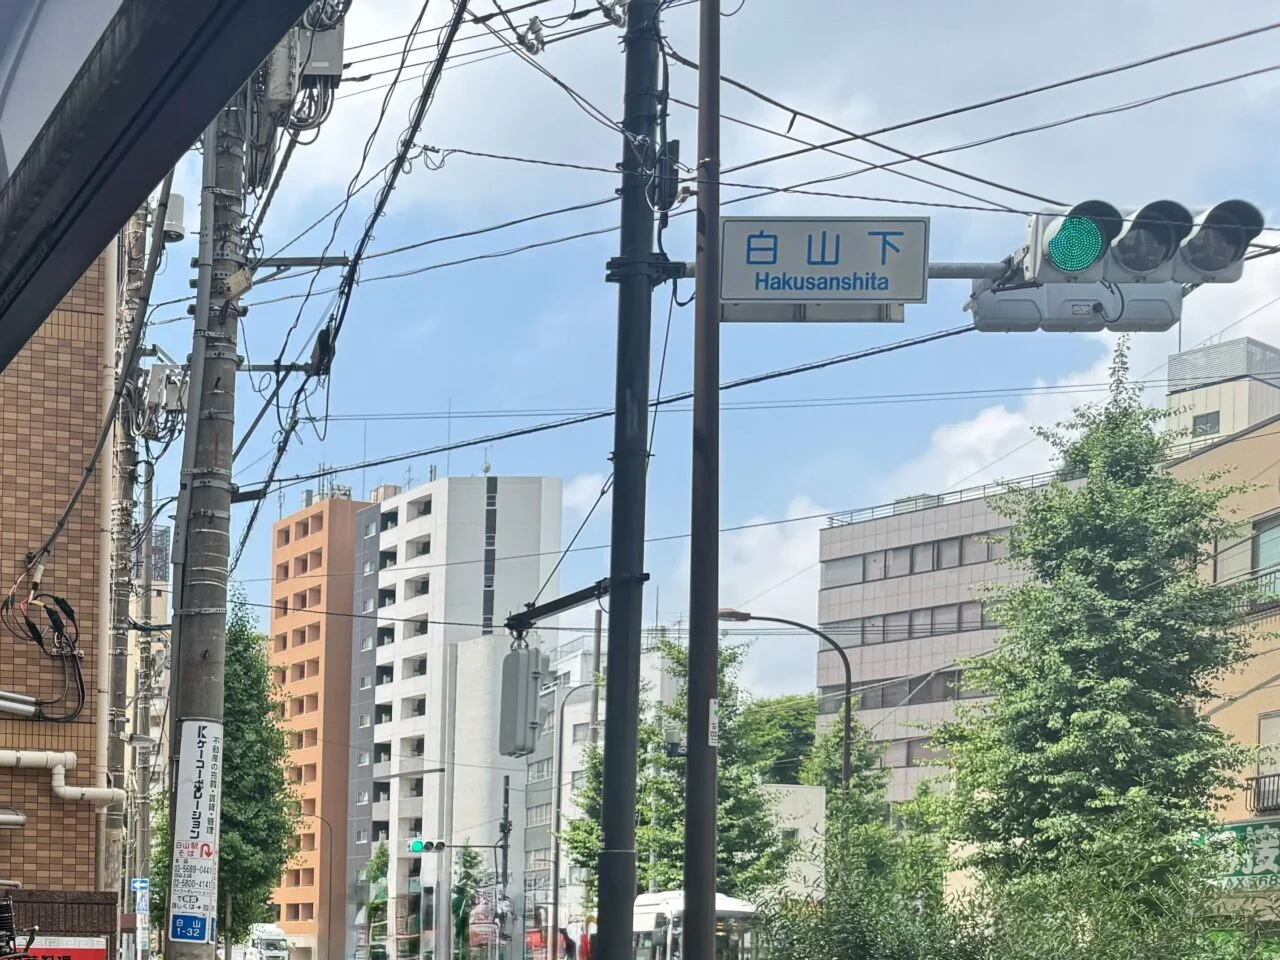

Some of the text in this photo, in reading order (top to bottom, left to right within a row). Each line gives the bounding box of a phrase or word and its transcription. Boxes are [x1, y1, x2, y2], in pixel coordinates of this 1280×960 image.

[746, 230, 904, 266] 白山下
[754, 271, 890, 292] Hakusanshita
[176, 927, 200, 937] 1-32
